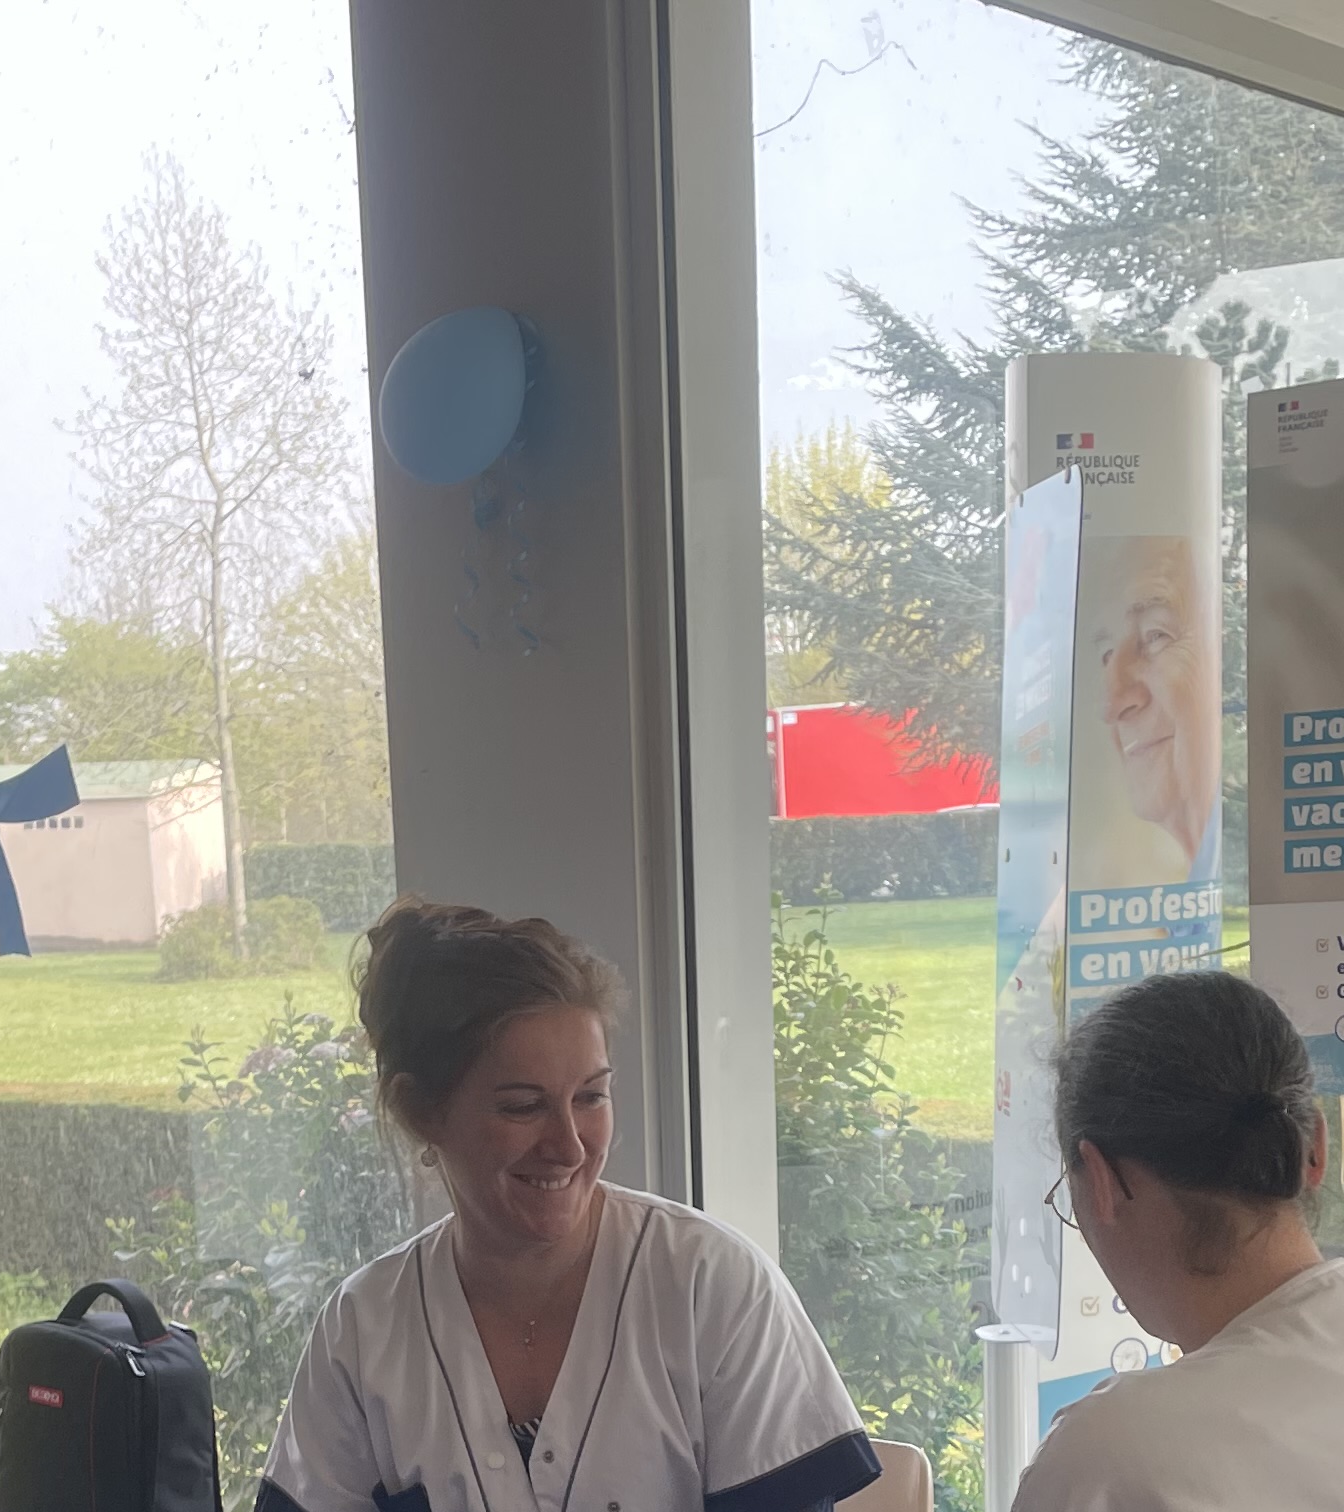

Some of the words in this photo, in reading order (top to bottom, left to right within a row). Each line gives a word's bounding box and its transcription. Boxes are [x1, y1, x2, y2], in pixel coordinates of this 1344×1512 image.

[1277, 408, 1330, 424] RÉPUBLIQUE
[1277, 419, 1325, 433] FRANÇAISE
[1056, 452, 1141, 470] RÉPUBLIQUE
[1084, 471, 1136, 488] NÇAISE
[1292, 757, 1336, 786] en
[1292, 842, 1343, 869] me
[1080, 950, 1131, 981] en
[1140, 942, 1210, 977] vous
